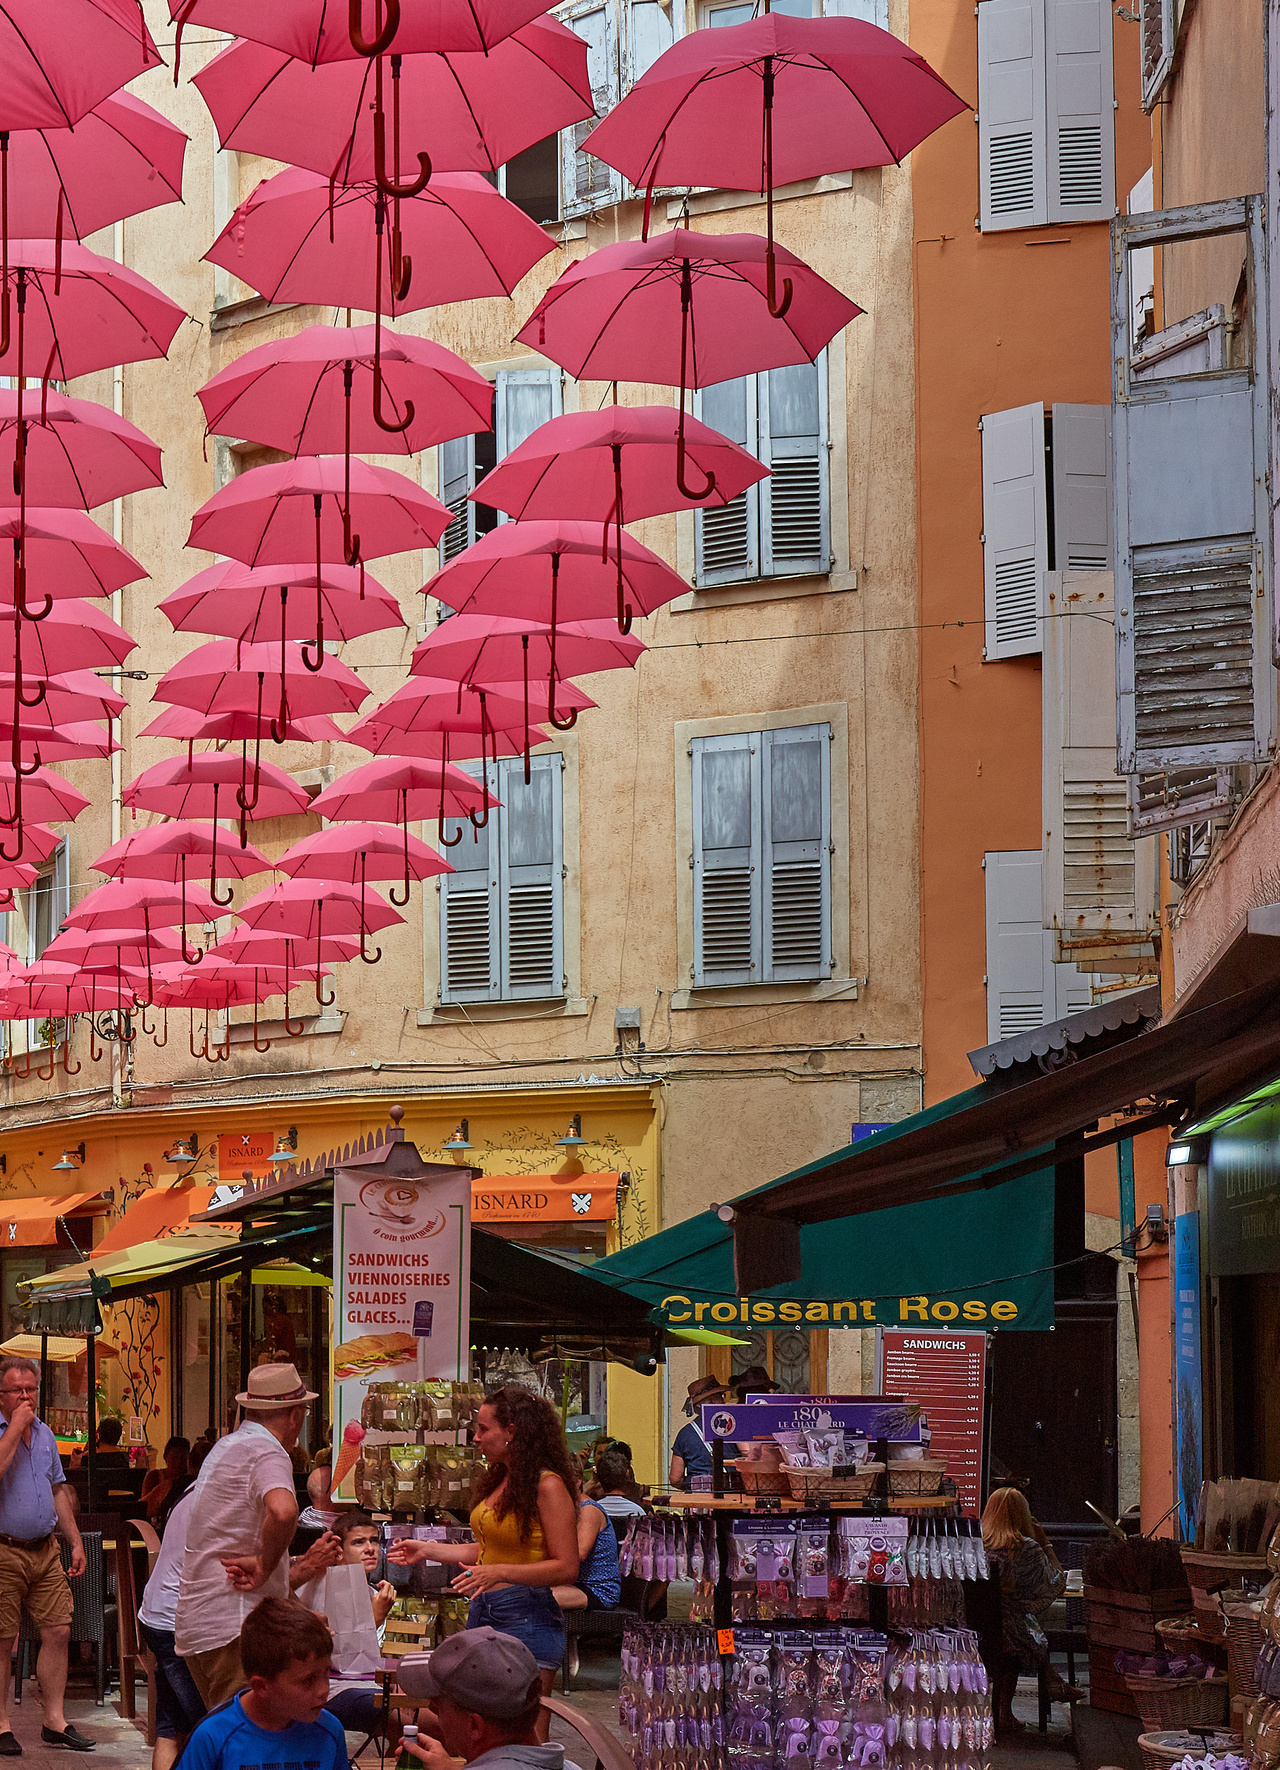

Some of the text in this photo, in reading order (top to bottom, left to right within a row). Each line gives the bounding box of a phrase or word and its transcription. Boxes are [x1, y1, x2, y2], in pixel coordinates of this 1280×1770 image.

[228, 1147, 264, 1158] ISNARD
[473, 1193, 548, 1210] ISNARD
[380, 1233, 398, 1241] coin
[348, 1253, 429, 1267] SANDWICHS
[348, 1272, 450, 1286] VIENNOISERIES
[347, 1291, 407, 1304] SALADES
[660, 1295, 1019, 1322] Croissant Rose
[347, 1310, 411, 1324] GLACES...
[903, 1340, 966, 1350] SANDWICHS
